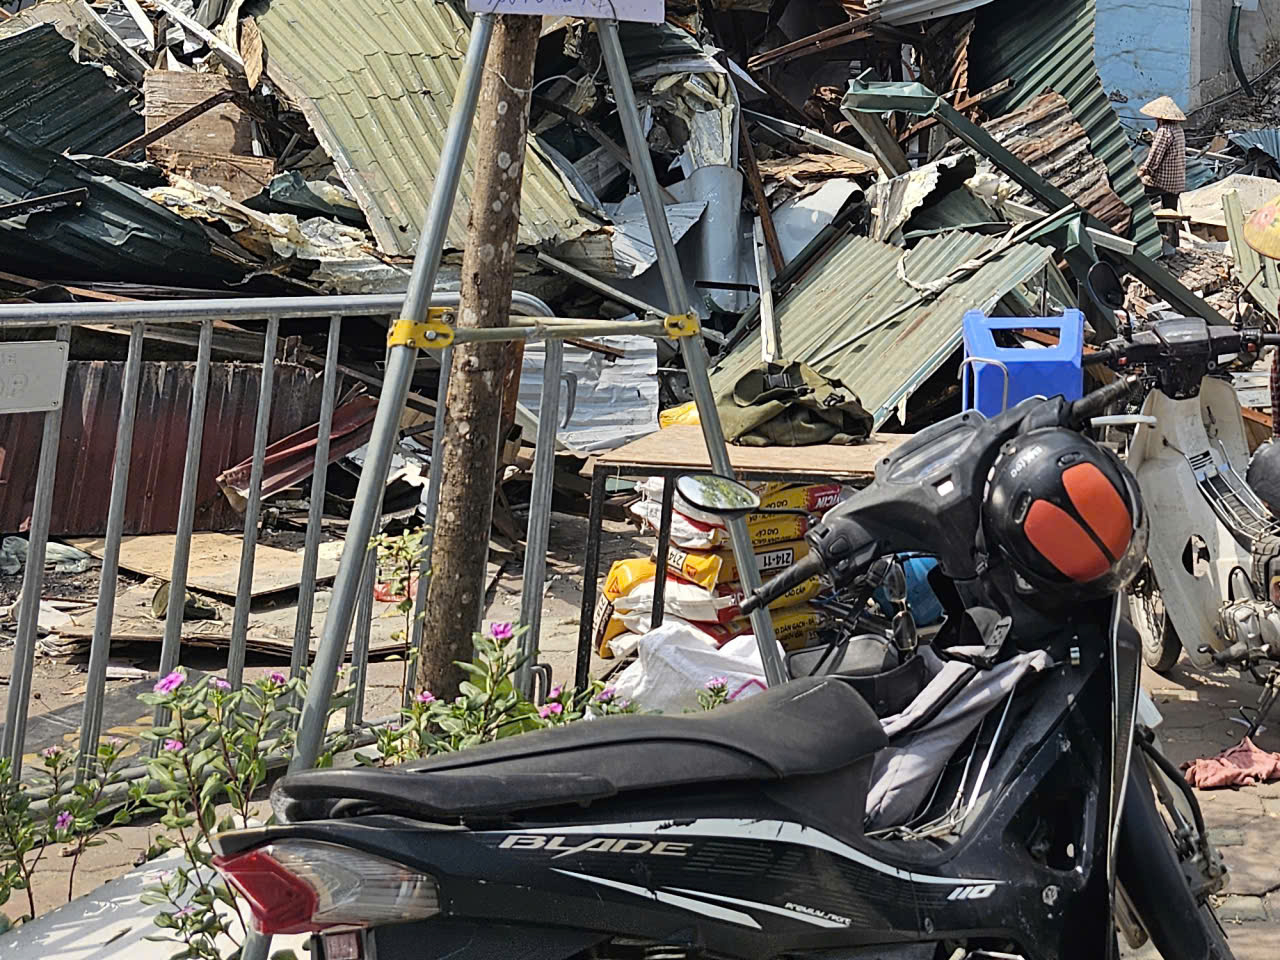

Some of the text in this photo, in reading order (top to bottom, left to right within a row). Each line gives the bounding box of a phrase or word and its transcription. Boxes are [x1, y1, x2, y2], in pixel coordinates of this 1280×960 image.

[763, 551, 792, 568] 214-11
[498, 834, 694, 859] BLADE
[946, 883, 997, 901] 110
